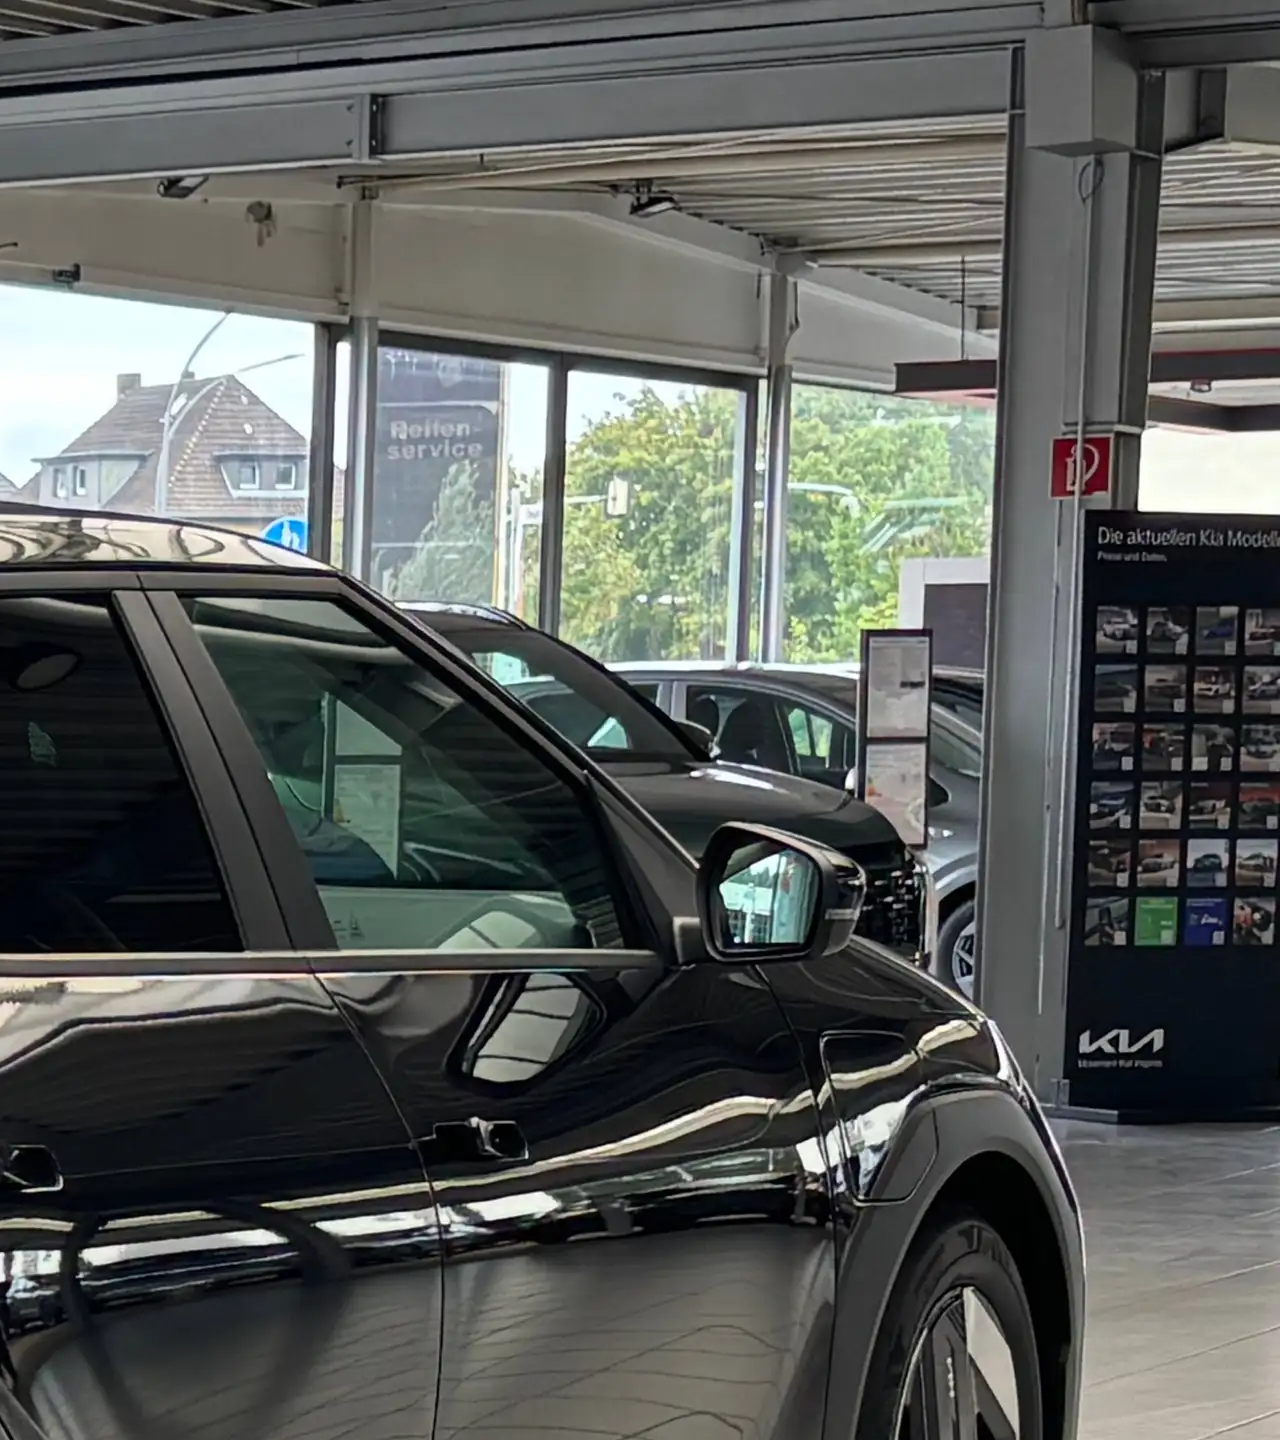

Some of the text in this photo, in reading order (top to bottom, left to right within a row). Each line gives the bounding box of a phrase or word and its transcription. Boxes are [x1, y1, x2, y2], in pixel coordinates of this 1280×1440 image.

[386, 439, 484, 461] service
[1097, 525, 1124, 545] Die
[1126, 527, 1196, 547] aktuellen
[1198, 528, 1224, 546] Kia
[1078, 1028, 1165, 1054] KIA
